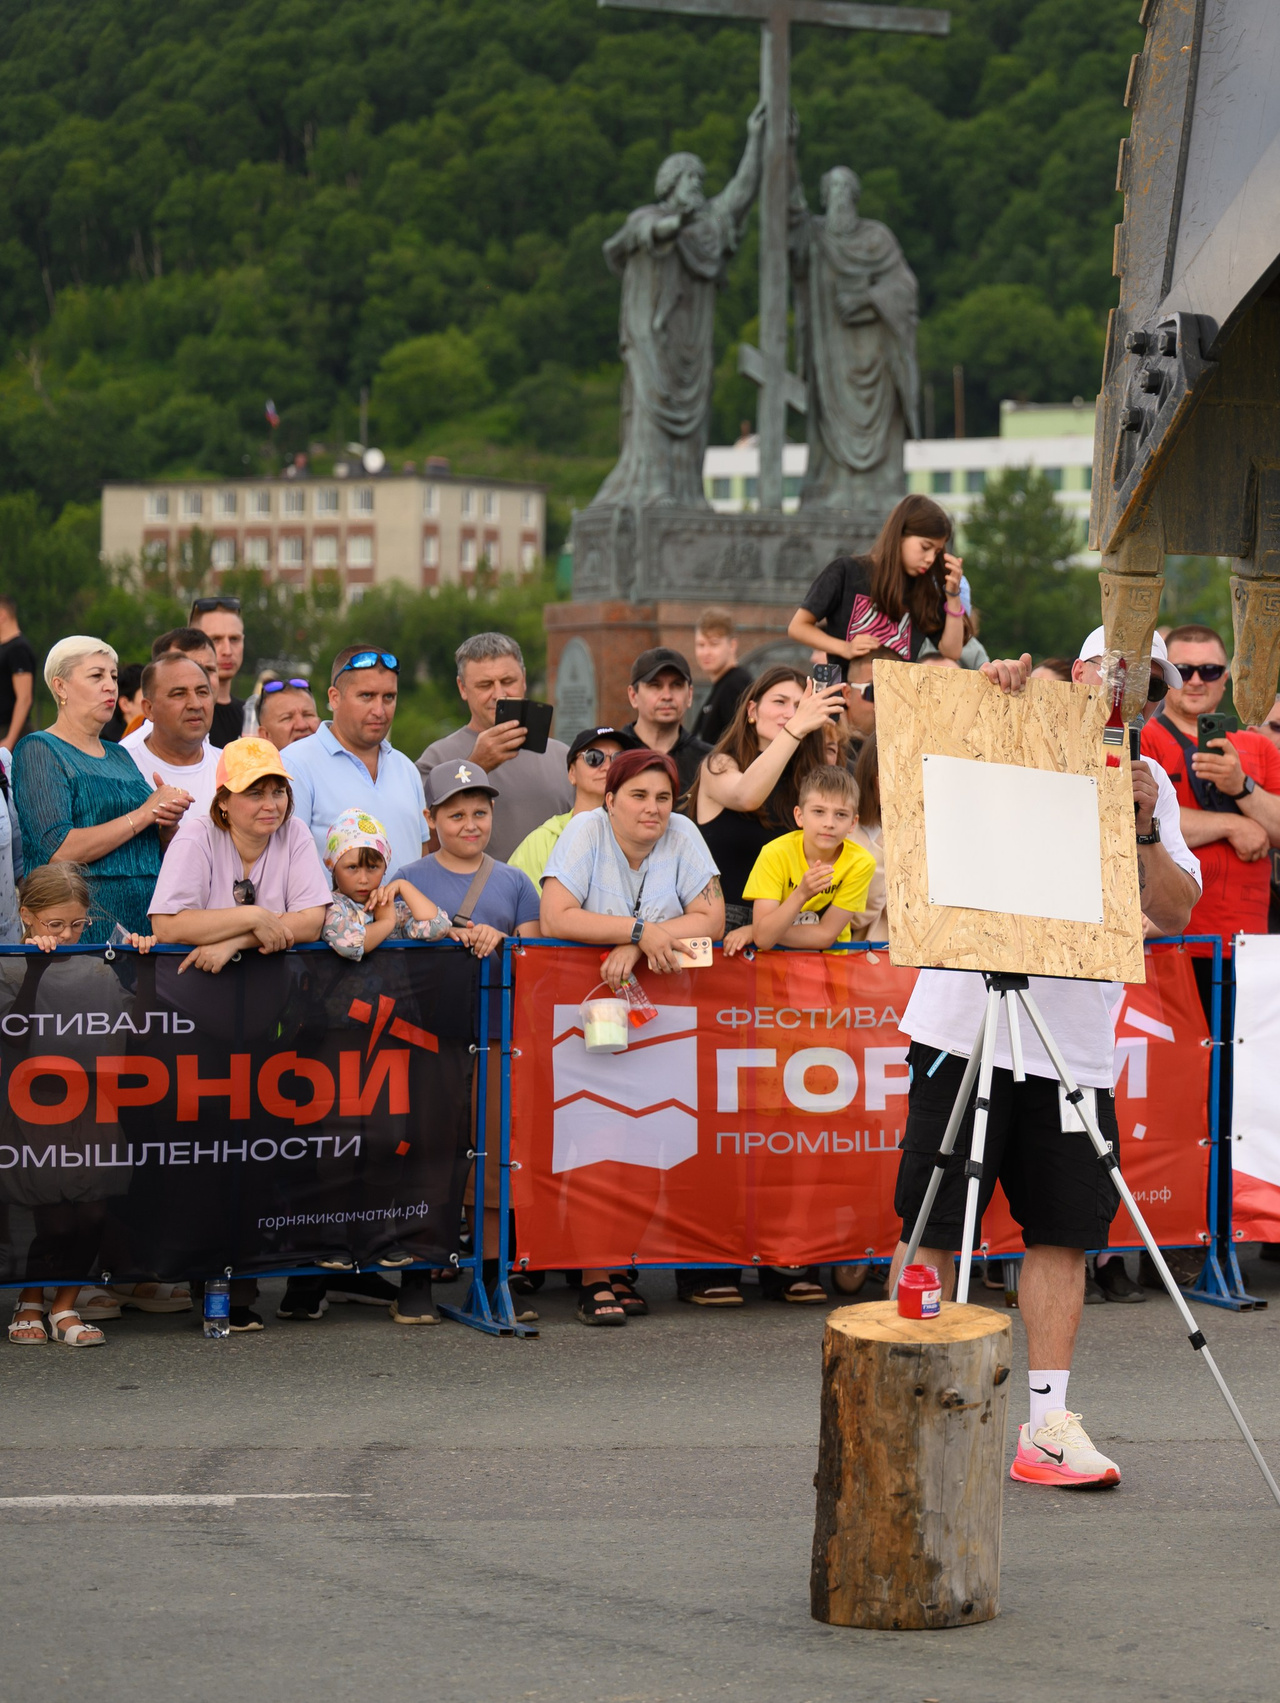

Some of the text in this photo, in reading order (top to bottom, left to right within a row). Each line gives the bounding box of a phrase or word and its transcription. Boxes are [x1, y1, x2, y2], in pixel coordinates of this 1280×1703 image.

[716, 1006, 900, 1029] ФЕСТИВА
[0, 994, 439, 1126] ОРНОЙ
[257, 1201, 429, 1229] горнякикамчатки.рф
